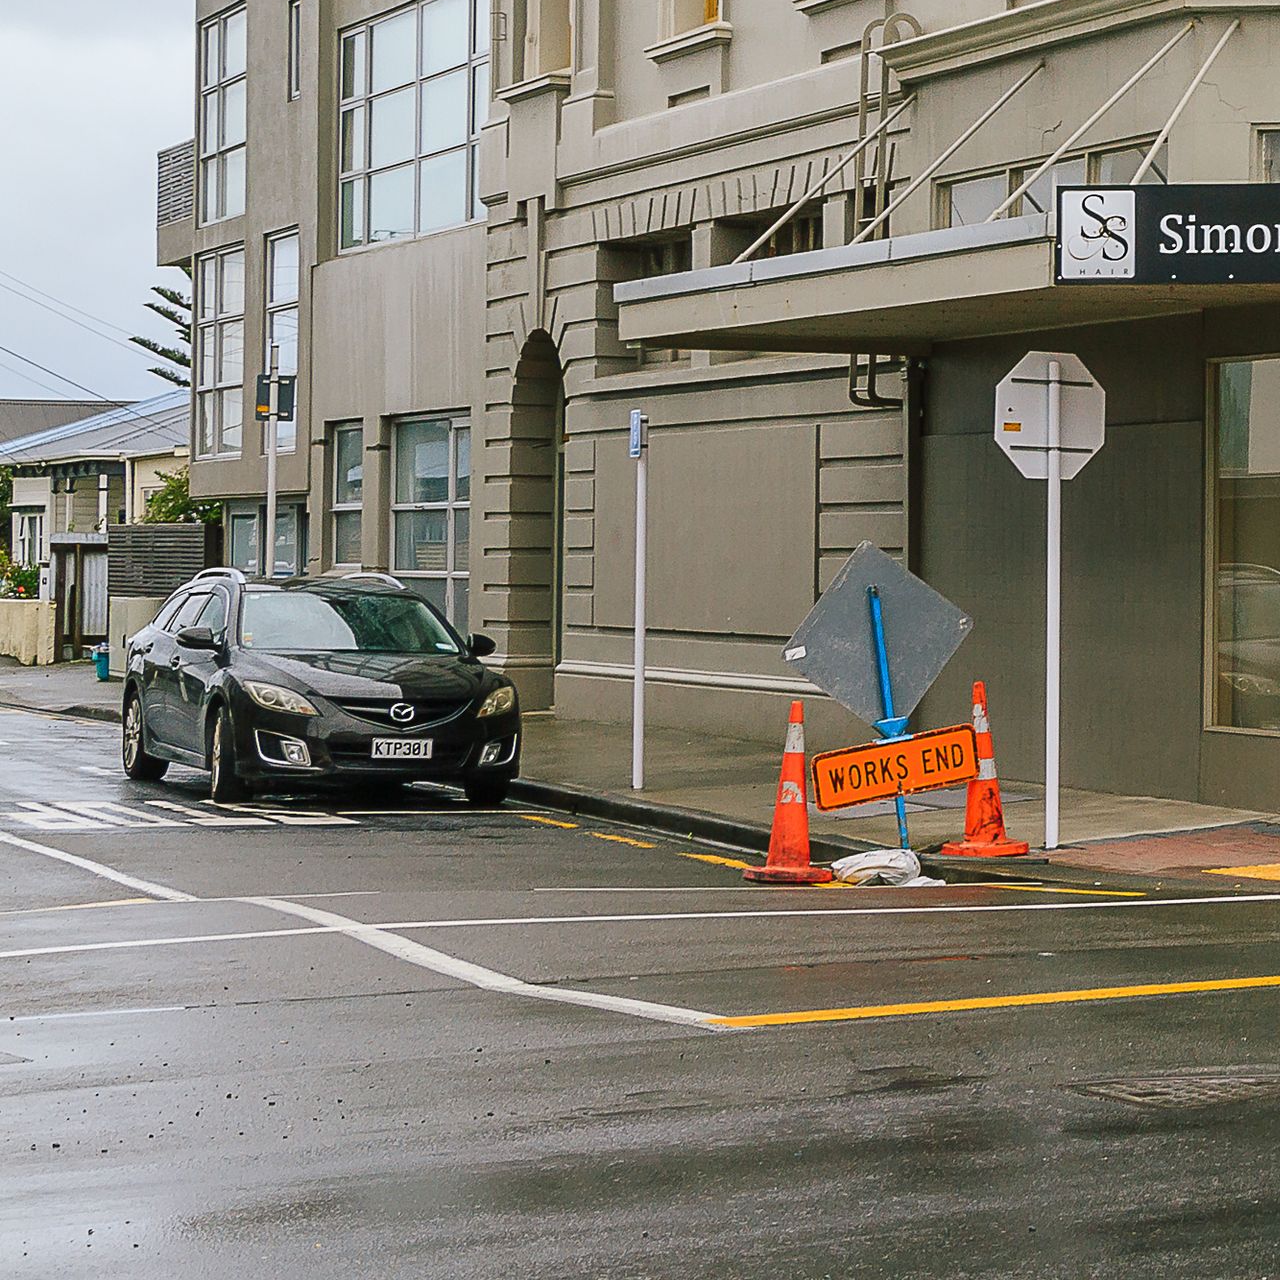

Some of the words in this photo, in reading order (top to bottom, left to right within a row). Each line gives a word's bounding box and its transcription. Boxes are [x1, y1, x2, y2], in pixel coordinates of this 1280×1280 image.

[374, 741, 429, 757] KTP301
[828, 754, 909, 794] WORKS
[922, 743, 965, 775] END
